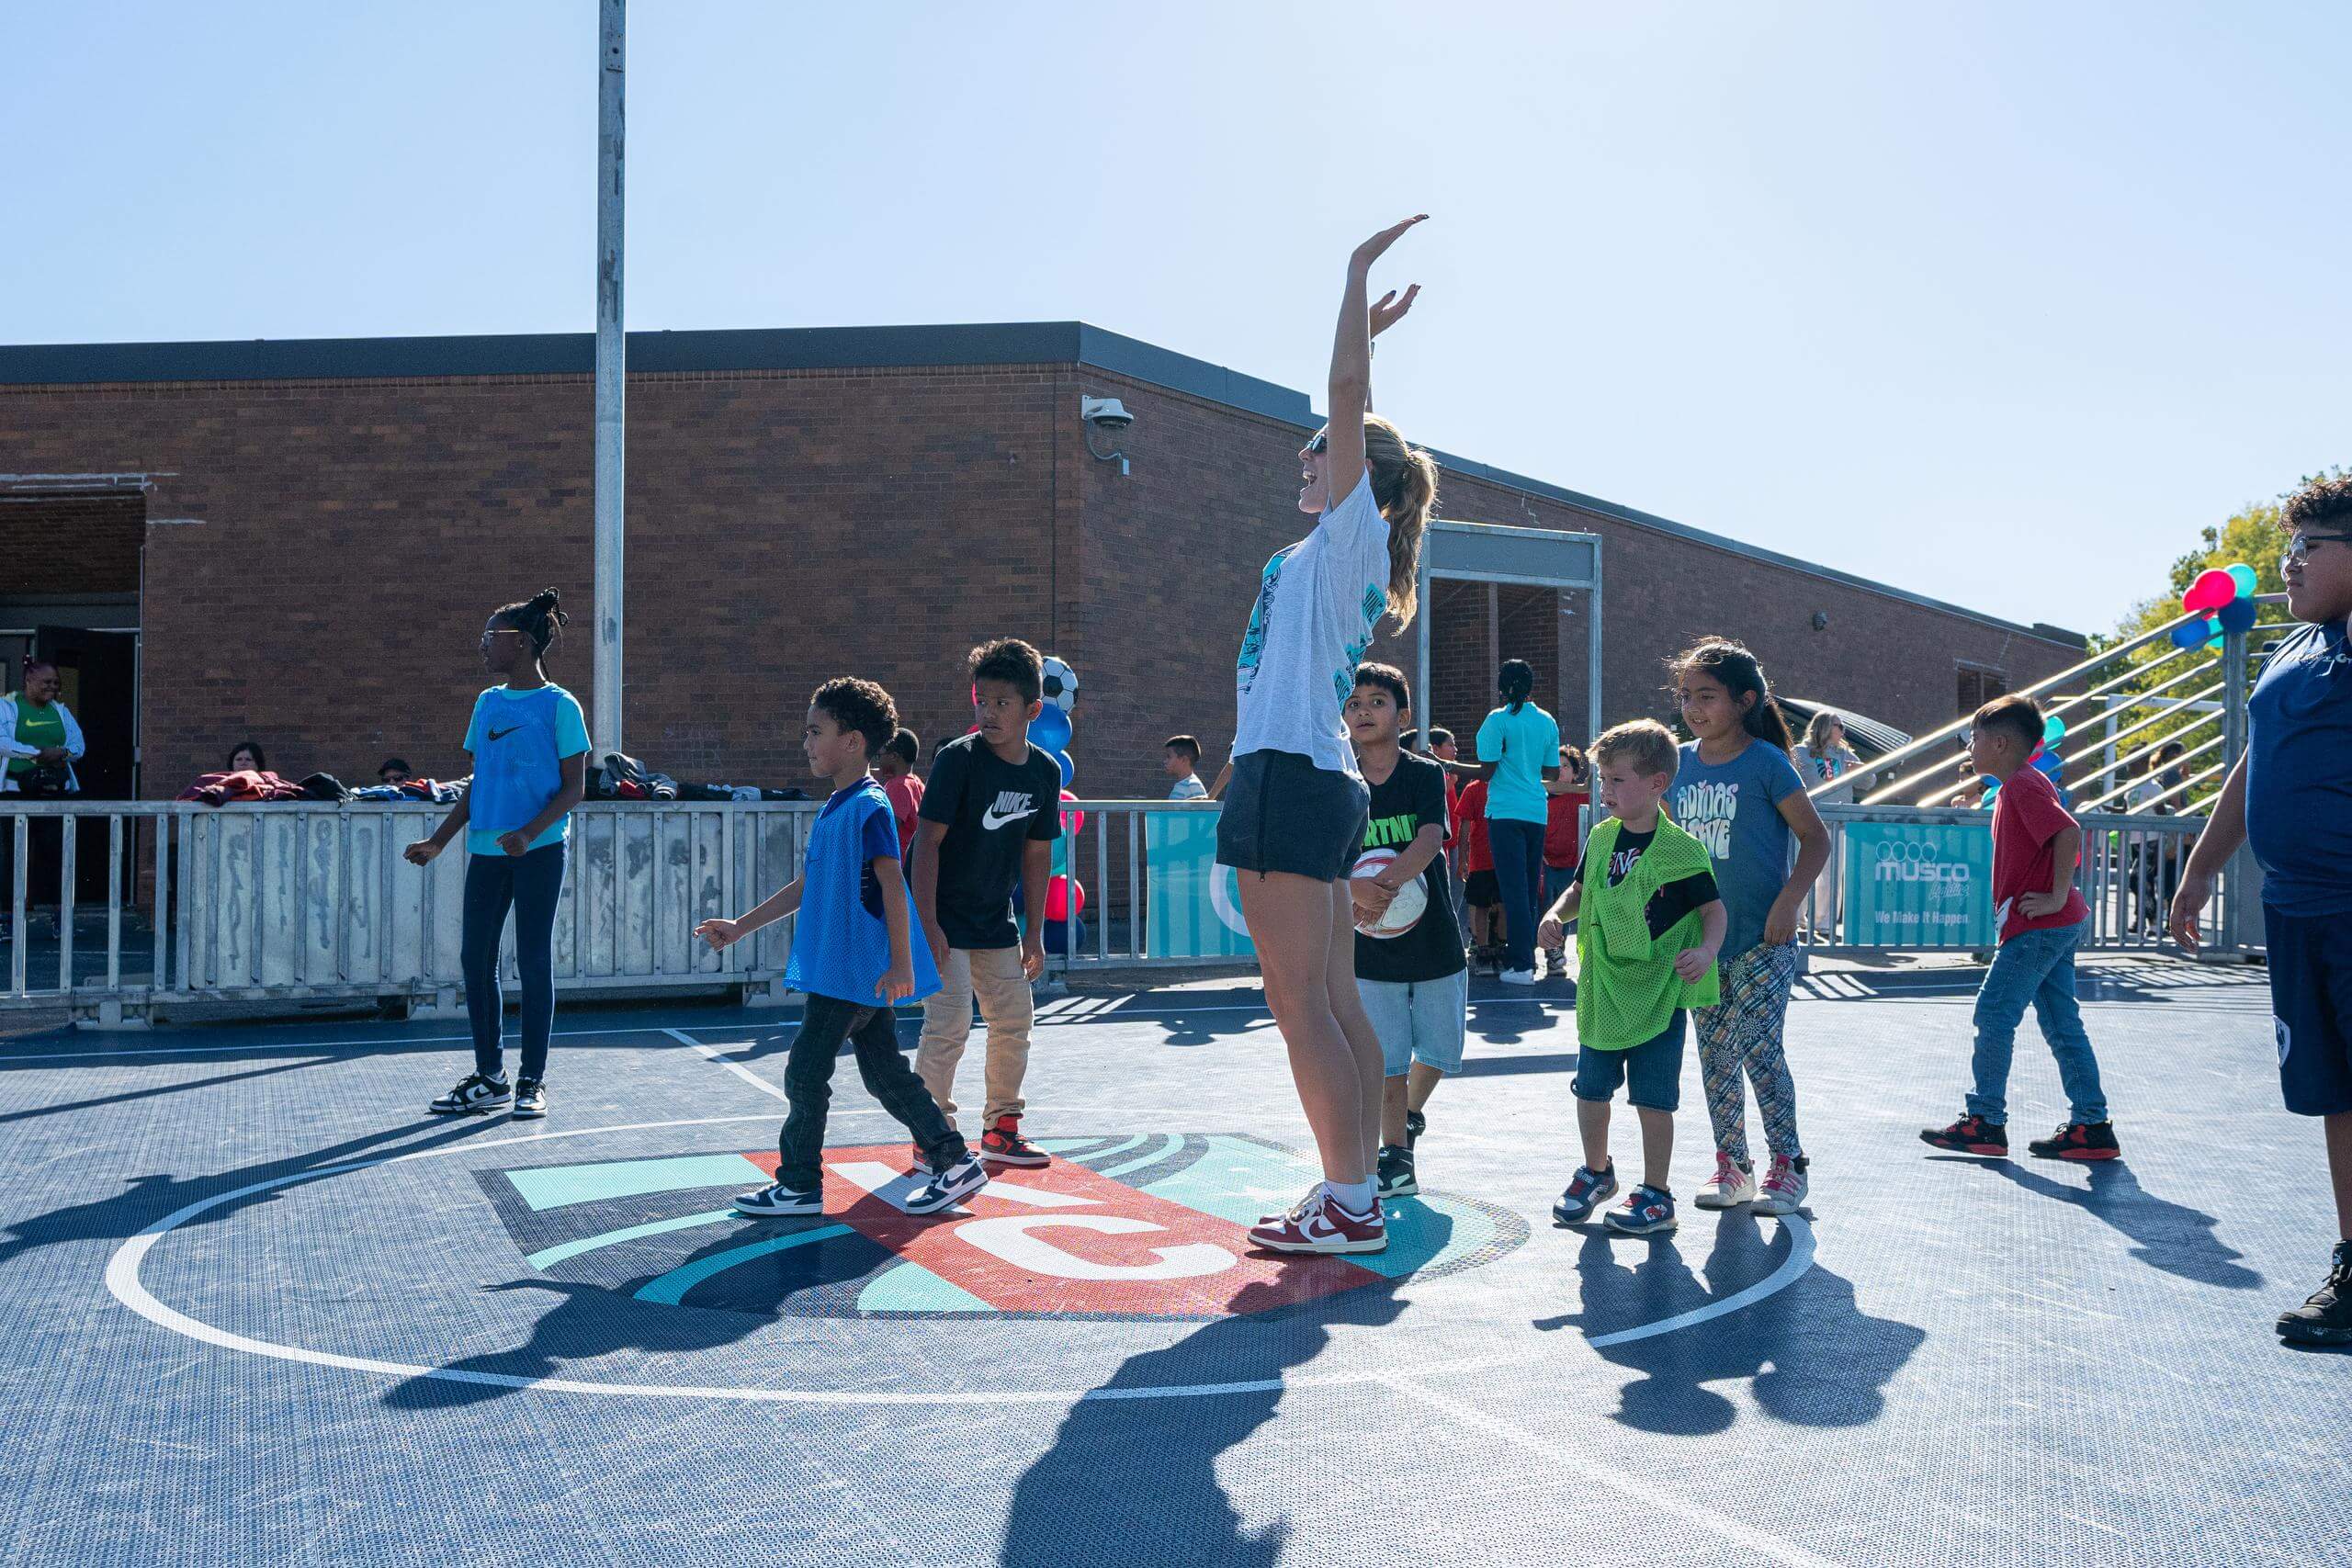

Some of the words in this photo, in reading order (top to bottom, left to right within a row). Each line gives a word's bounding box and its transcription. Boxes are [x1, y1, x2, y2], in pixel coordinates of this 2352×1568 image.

[992, 791, 1033, 813] NIKE
[1875, 910, 1891, 924] We
[1893, 910, 1920, 924] Make
[1922, 910, 1930, 924] It
